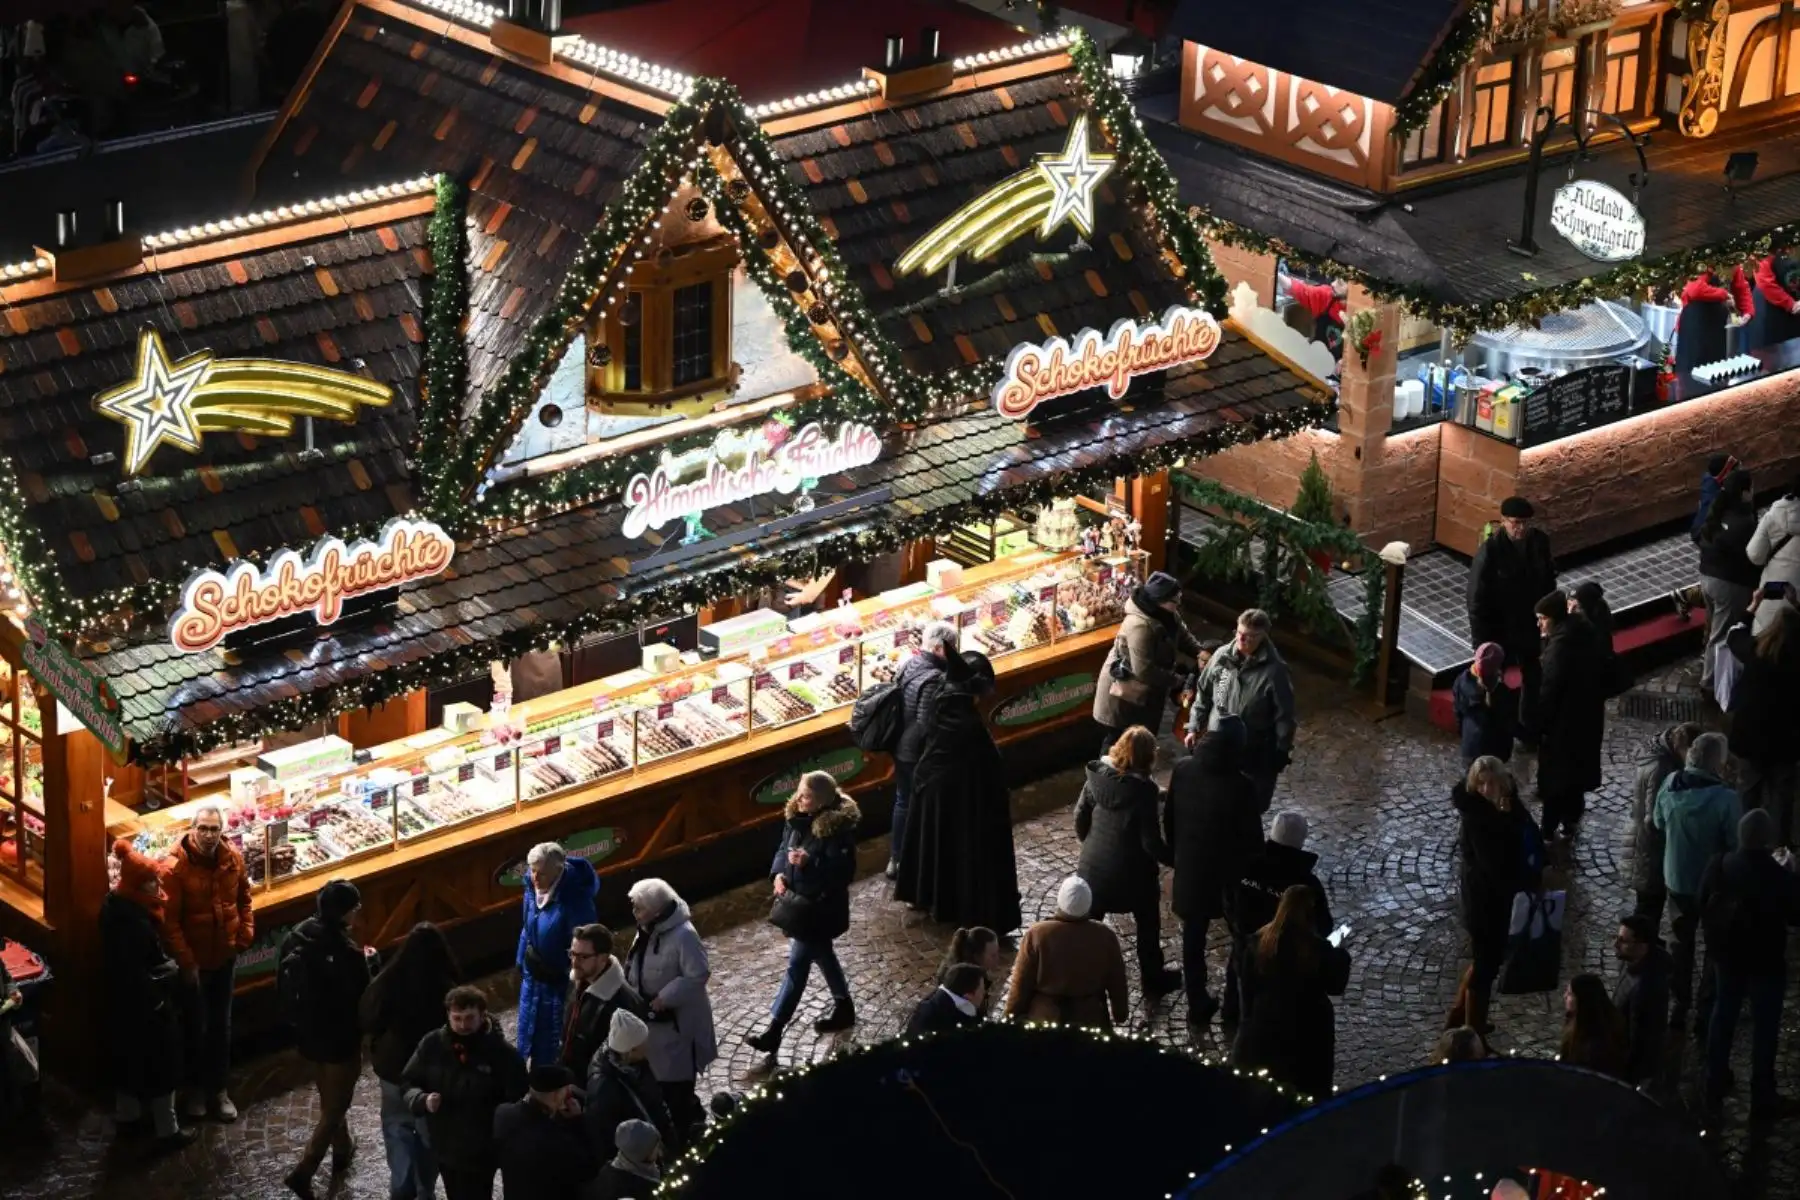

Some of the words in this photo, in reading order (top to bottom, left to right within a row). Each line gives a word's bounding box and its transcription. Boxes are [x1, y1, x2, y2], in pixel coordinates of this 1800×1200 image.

[1551, 205, 1639, 251] Schwenkgrill
[1571, 187, 1625, 221] Altstadt
[1003, 313, 1216, 413] Schokofrüchte
[626, 449, 778, 528] Himmlische
[783, 421, 881, 485] Früchte
[177, 528, 447, 647] Schokofrüchte
